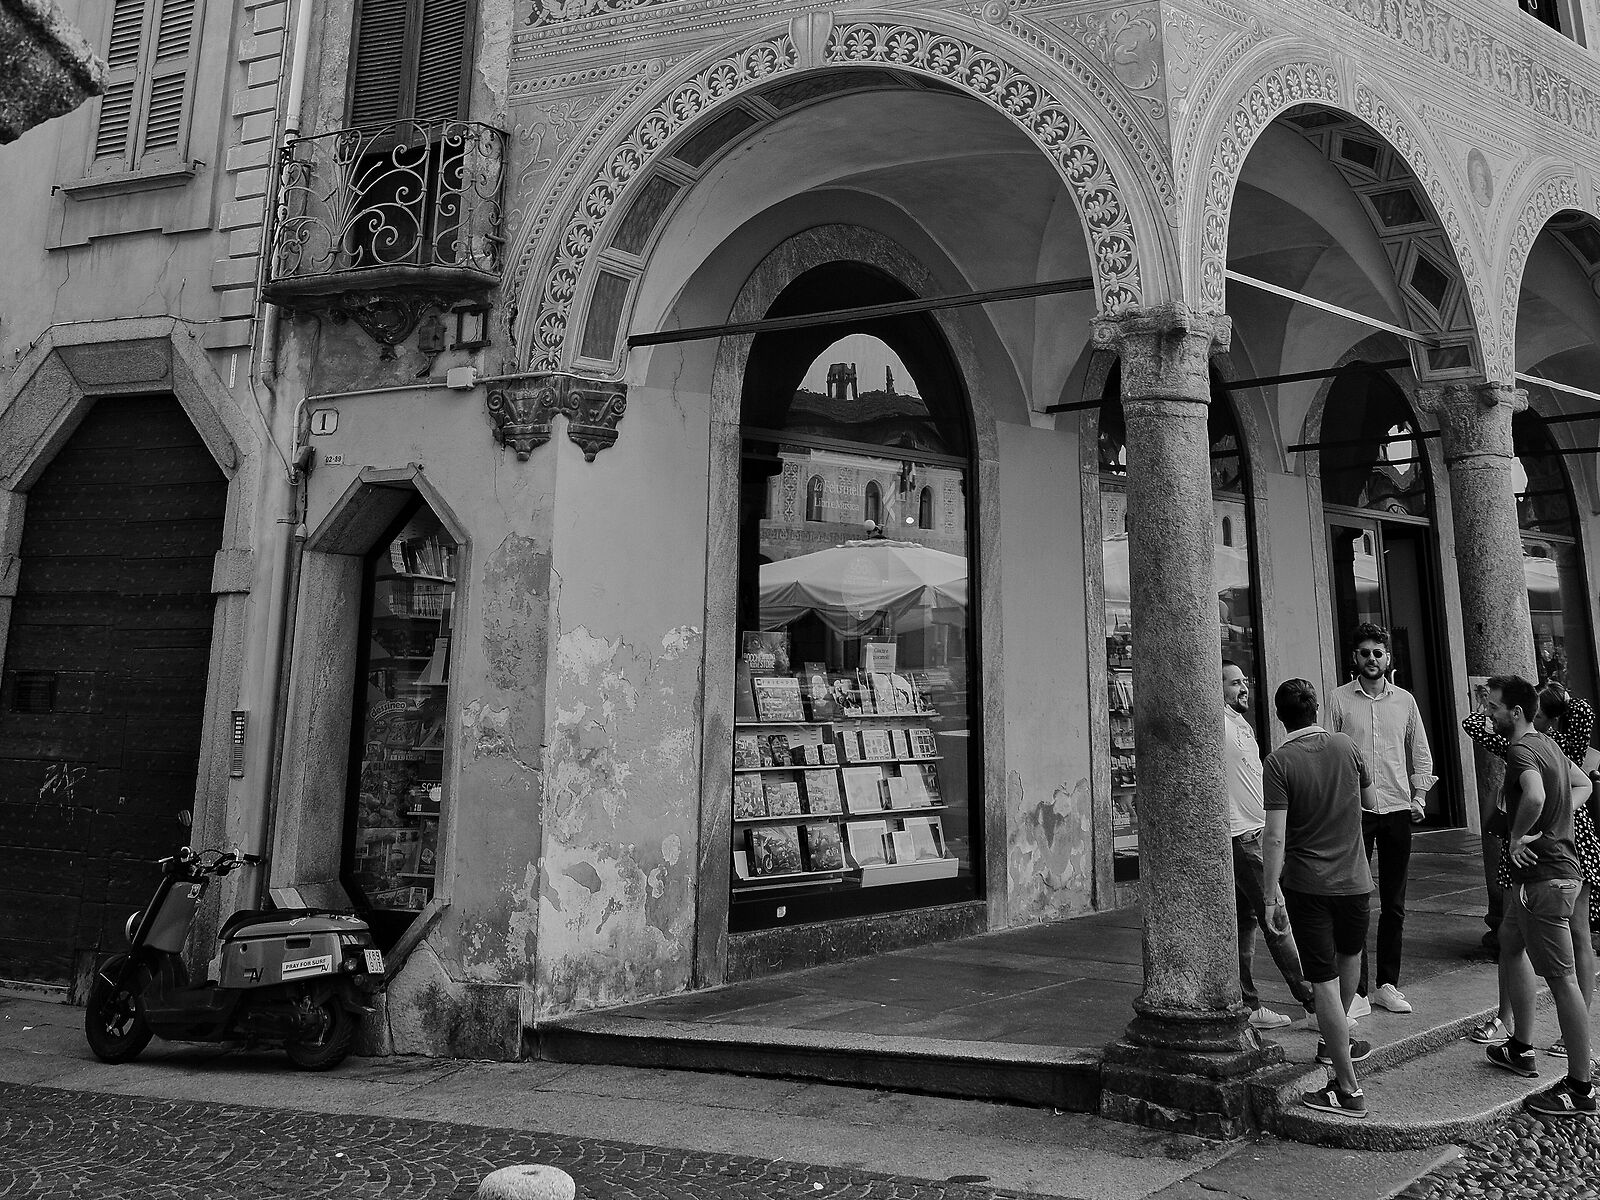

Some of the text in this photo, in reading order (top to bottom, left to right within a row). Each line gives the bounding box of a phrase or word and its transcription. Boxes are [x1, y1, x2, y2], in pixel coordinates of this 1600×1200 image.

[321, 413, 327, 430] 1
[370, 701, 407, 719] dessineo
[311, 958, 326, 966] SURF
